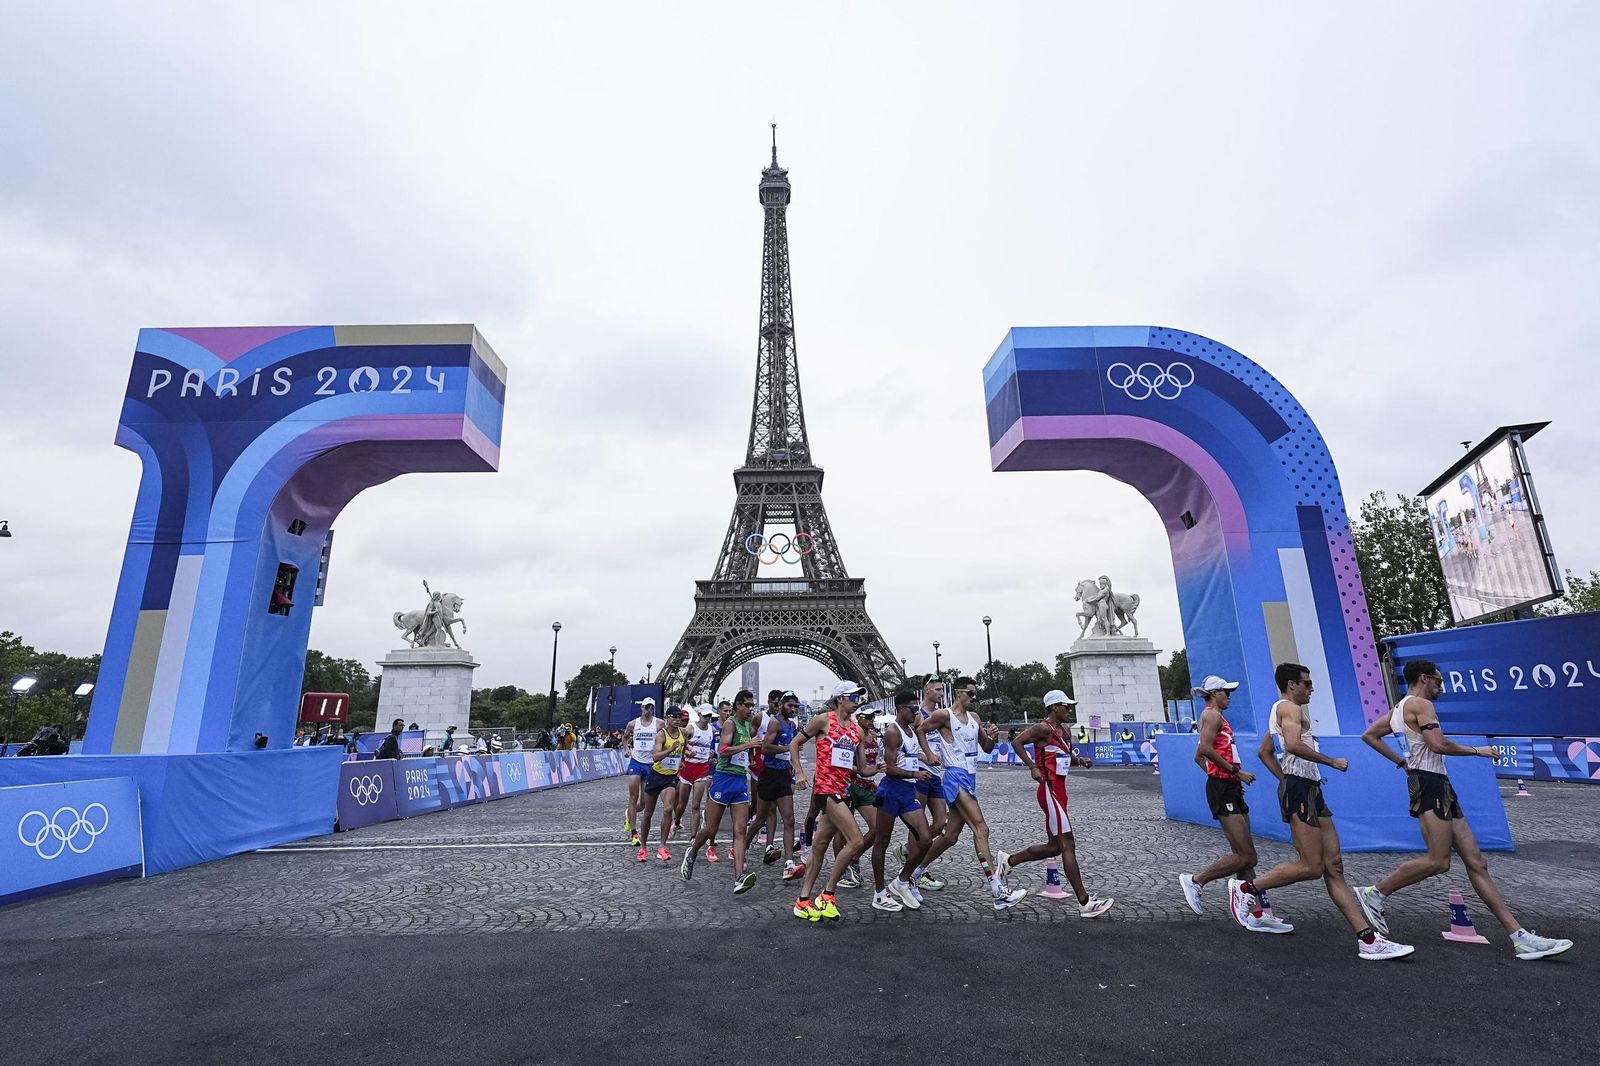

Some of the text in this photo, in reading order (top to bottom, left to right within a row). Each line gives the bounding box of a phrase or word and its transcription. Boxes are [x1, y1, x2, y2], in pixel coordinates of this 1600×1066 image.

[314, 364, 446, 396] 2024
[320, 698, 343, 716] 11
[841, 751, 850, 759] 60
[1492, 757, 1518, 768] 024
[407, 785, 431, 801] 2024
